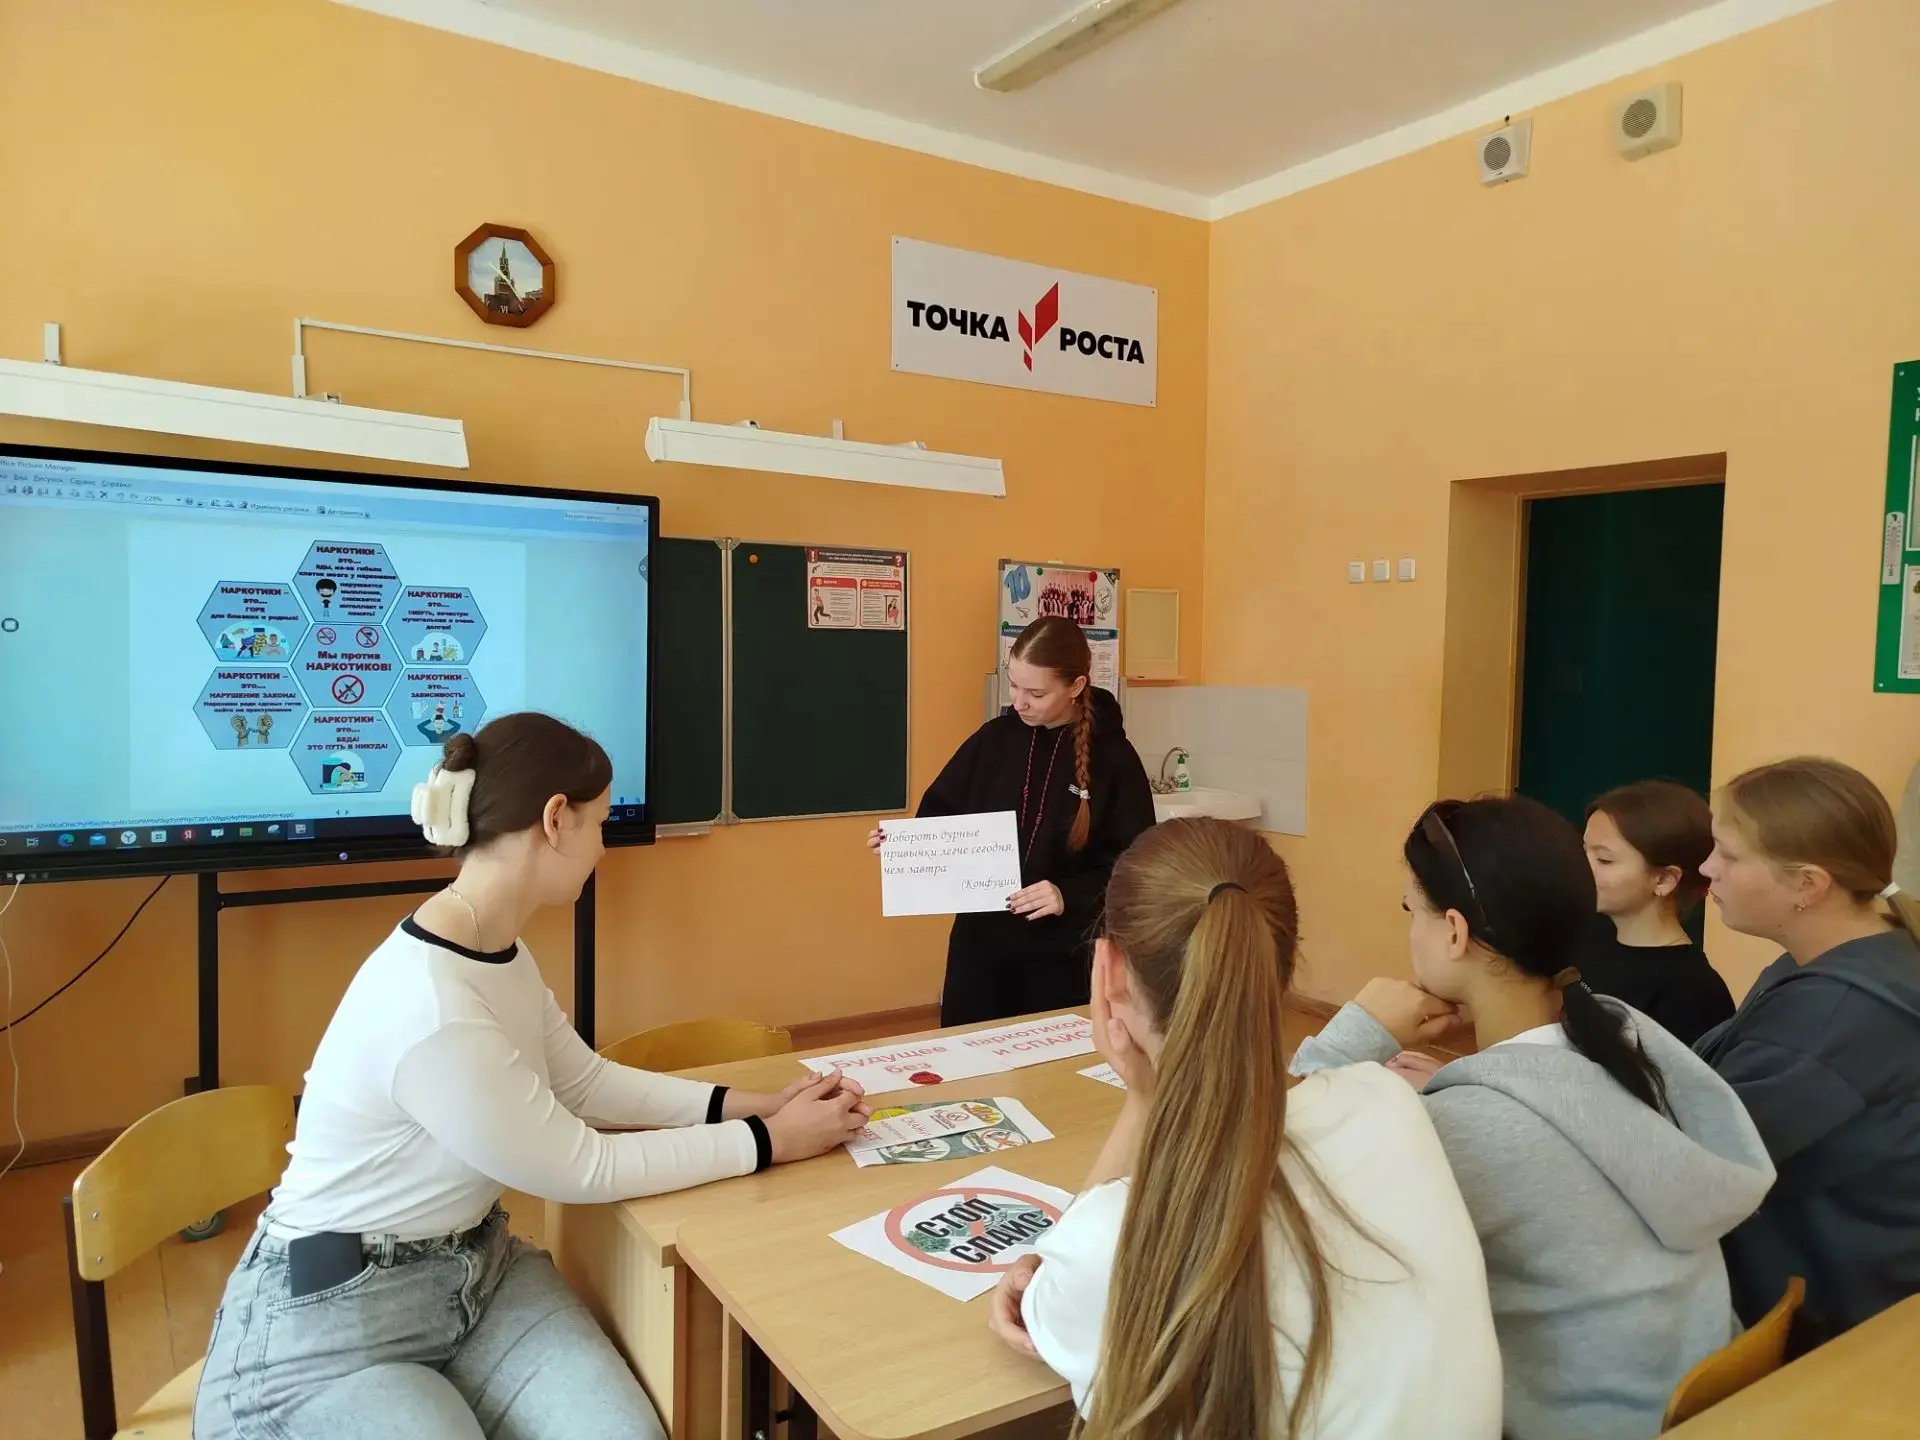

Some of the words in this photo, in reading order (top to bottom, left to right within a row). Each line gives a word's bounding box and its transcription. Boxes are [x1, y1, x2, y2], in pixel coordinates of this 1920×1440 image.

[907, 300, 1010, 343] ТОЧКА
[1059, 327, 1145, 364] РОСТА
[316, 546, 375, 555] НАРКОТИКИ
[221, 587, 281, 595] НАРКОТИКИ
[408, 591, 462, 599] НАРКОТИКИ
[318, 651, 337, 659] Мы
[341, 653, 381, 661] против
[306, 663, 392, 671] НАРКОТИКОВ!
[313, 716, 374, 724] НАРКОТИКИ
[883, 831, 938, 845] Побороть
[941, 828, 980, 842] дурные
[883, 847, 937, 861] привычки
[940, 845, 969, 857] легче
[883, 866, 904, 875] чем
[907, 864, 948, 877] завтра
[829, 1045, 948, 1069] Будущее
[992, 1048, 1009, 1057] и
[884, 1061, 932, 1074] без
[915, 1198, 1000, 1238] СТОП
